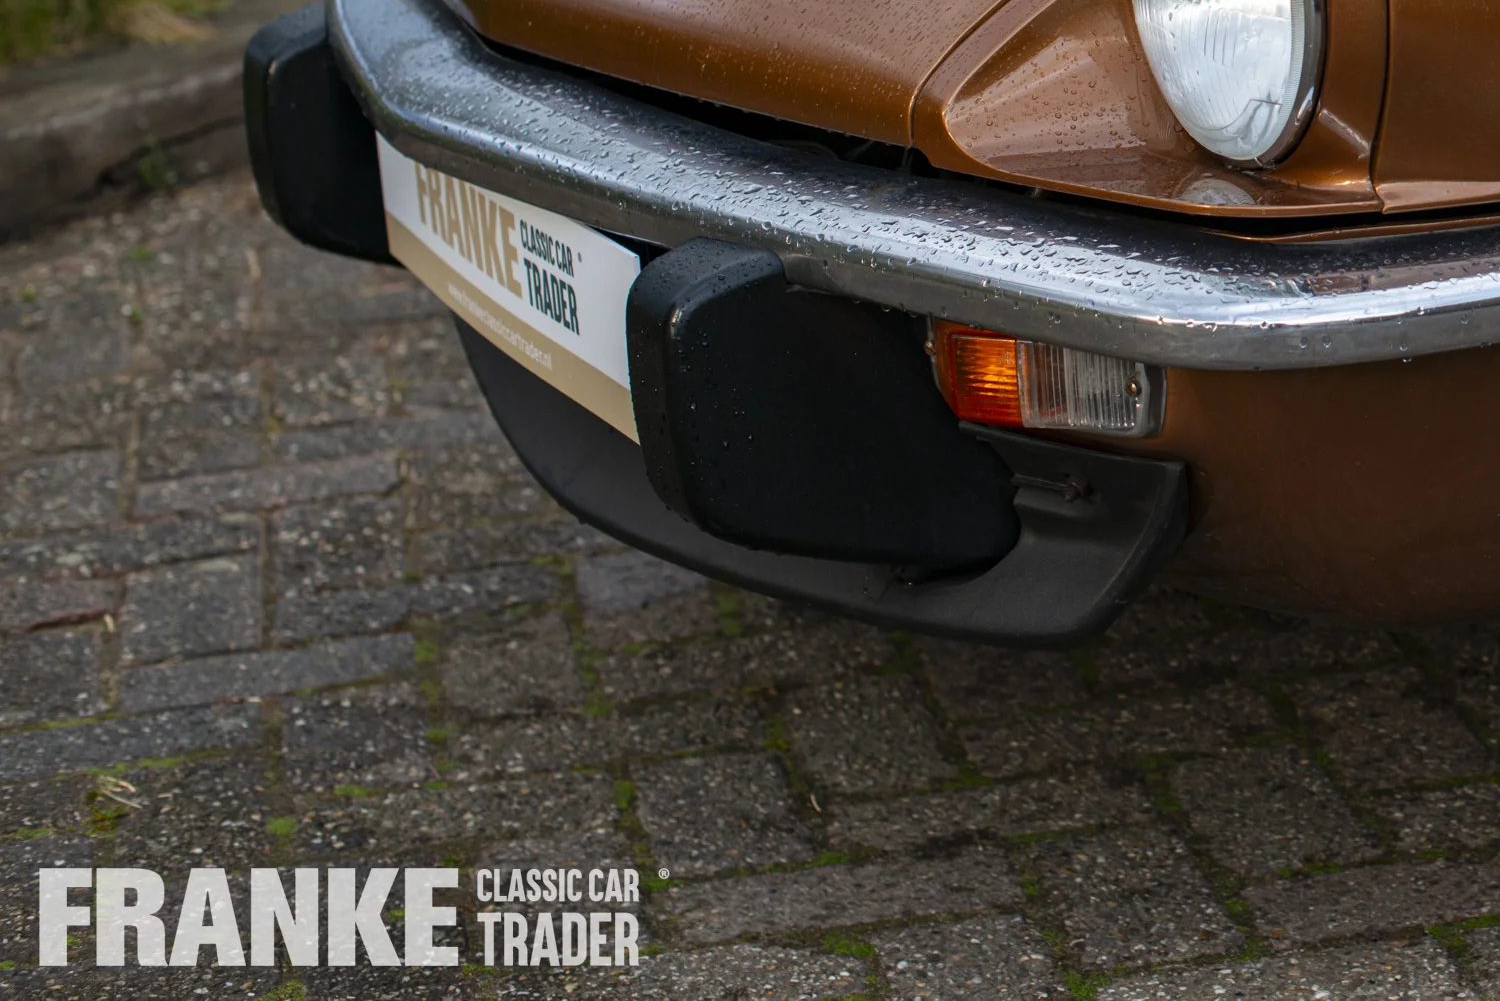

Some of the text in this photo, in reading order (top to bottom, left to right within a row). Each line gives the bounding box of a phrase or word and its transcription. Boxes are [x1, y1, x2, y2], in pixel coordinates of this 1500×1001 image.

[414, 162, 523, 299] FRANKE
[519, 219, 575, 278] CLASSIC CAR
[523, 258, 581, 336] TRADER
